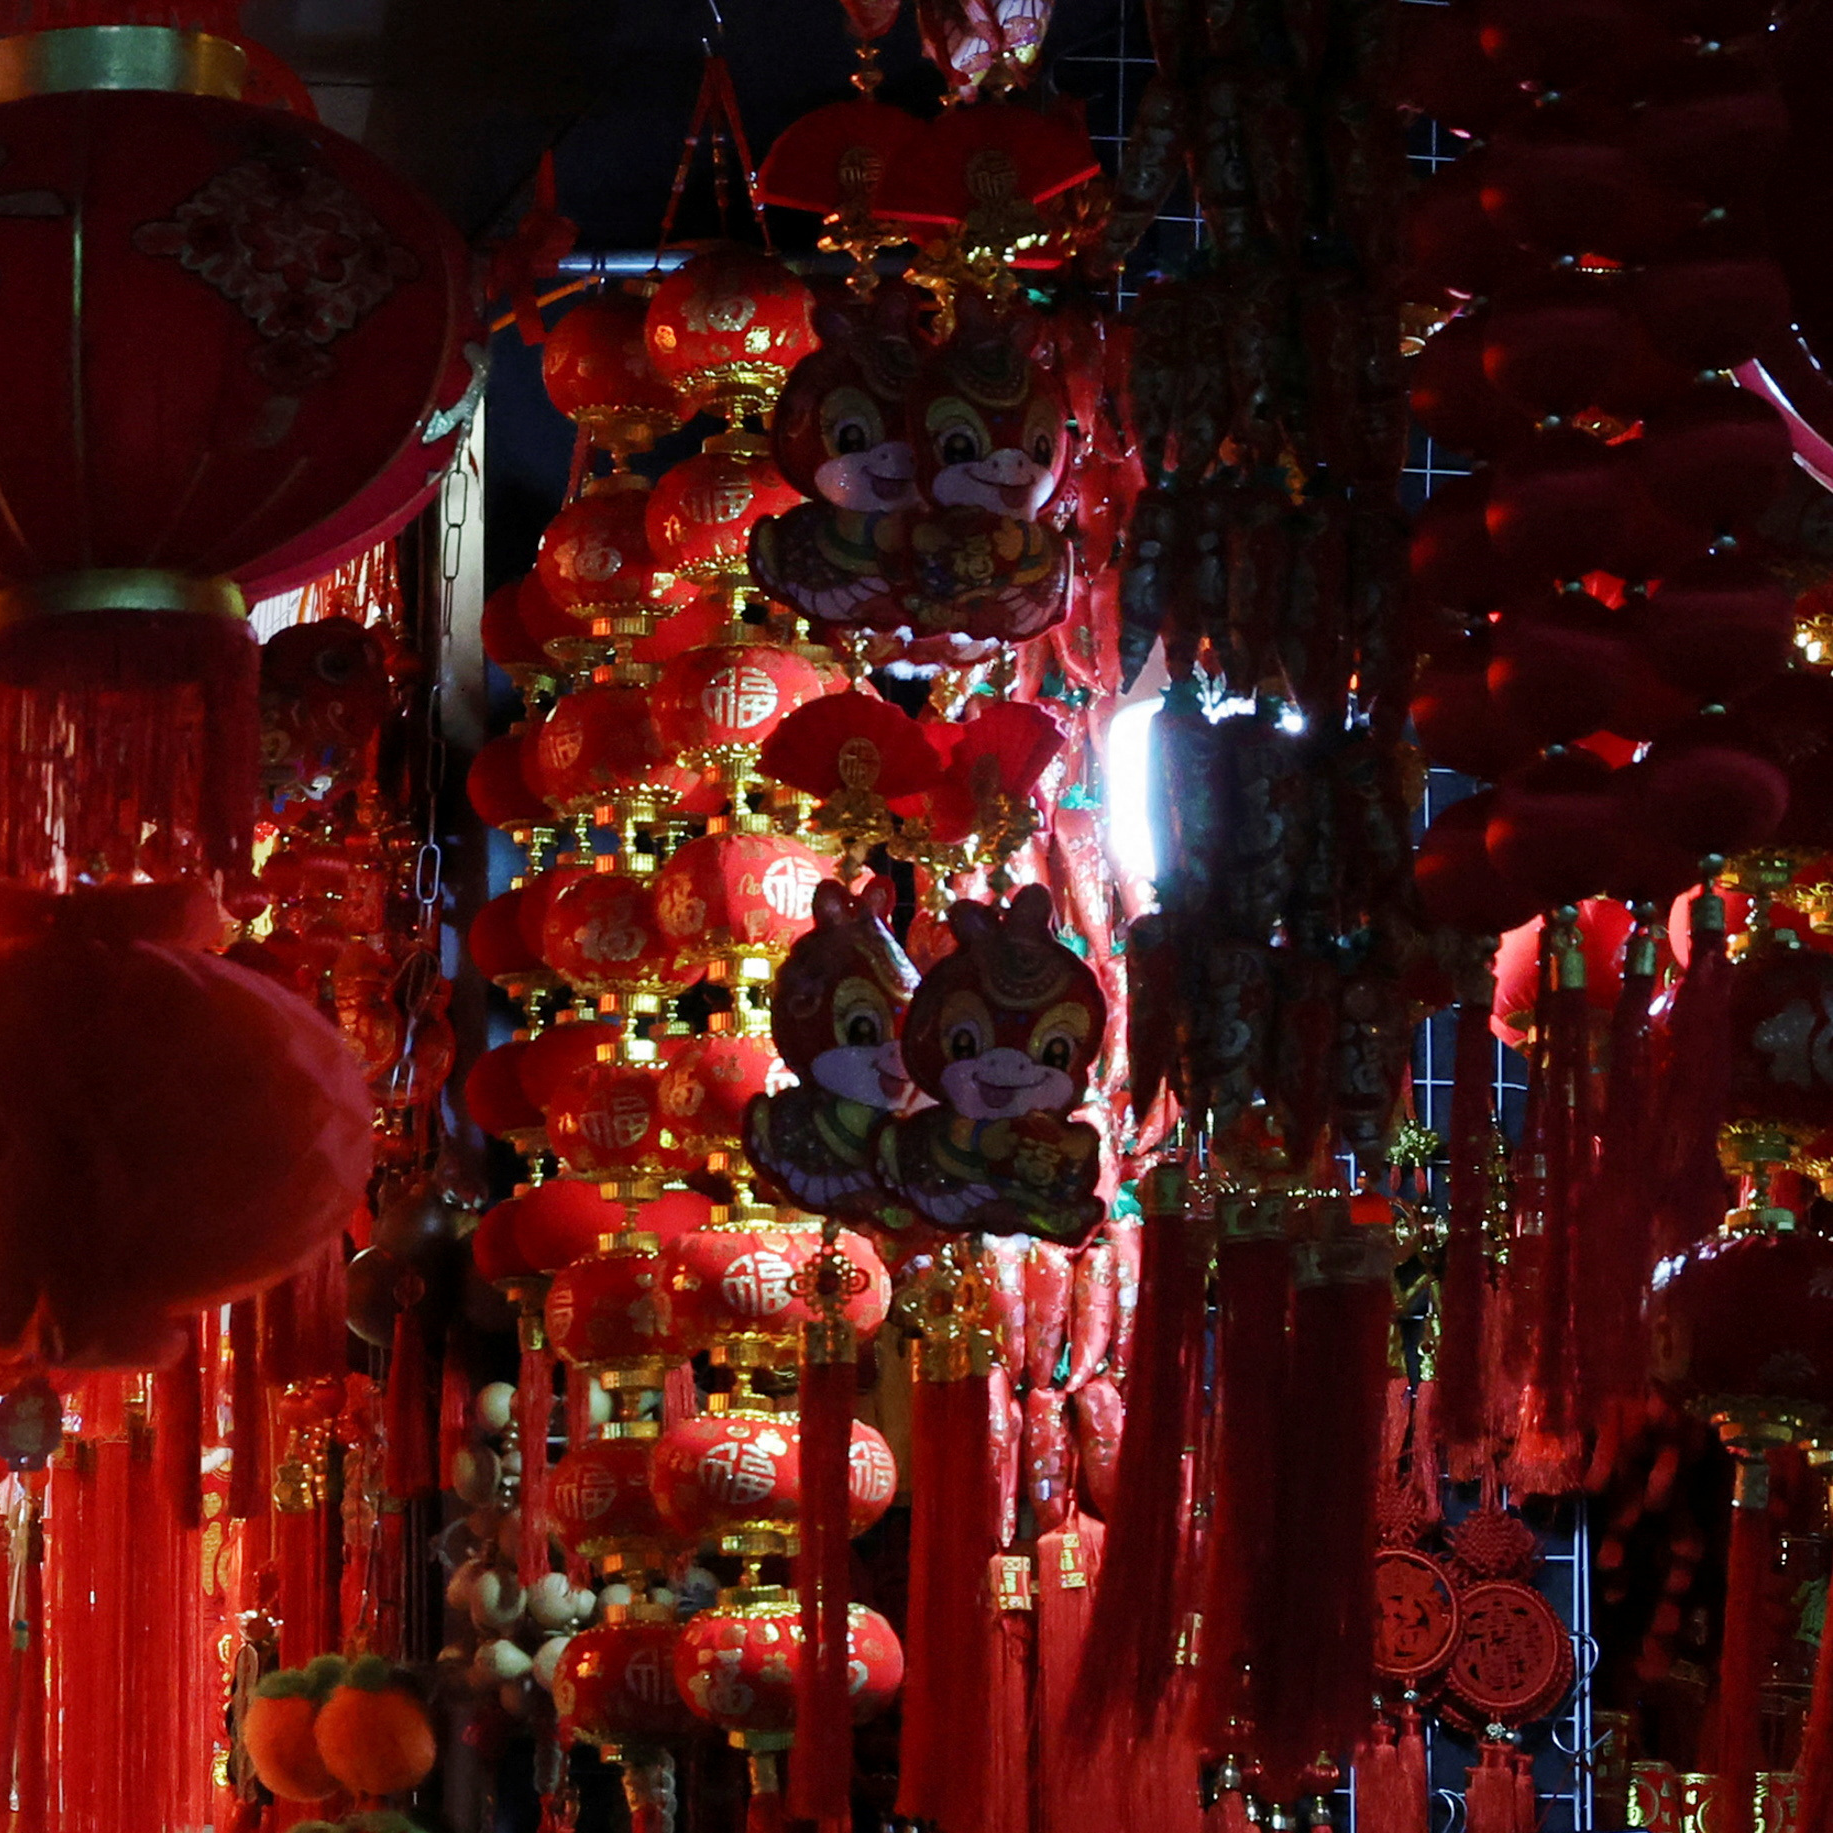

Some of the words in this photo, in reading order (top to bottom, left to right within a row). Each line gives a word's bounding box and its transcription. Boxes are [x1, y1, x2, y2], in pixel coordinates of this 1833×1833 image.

[838, 146, 885, 192] 福
[965, 149, 1018, 198] 福
[683, 473, 753, 525] 福
[700, 667, 779, 729] 福
[535, 718, 585, 770] 福
[837, 738, 881, 790] 福
[763, 855, 819, 919] 福
[579, 1086, 652, 1151] 福
[721, 1254, 793, 1317] 福
[554, 1463, 612, 1520] 福
[696, 1441, 776, 1504] 福
